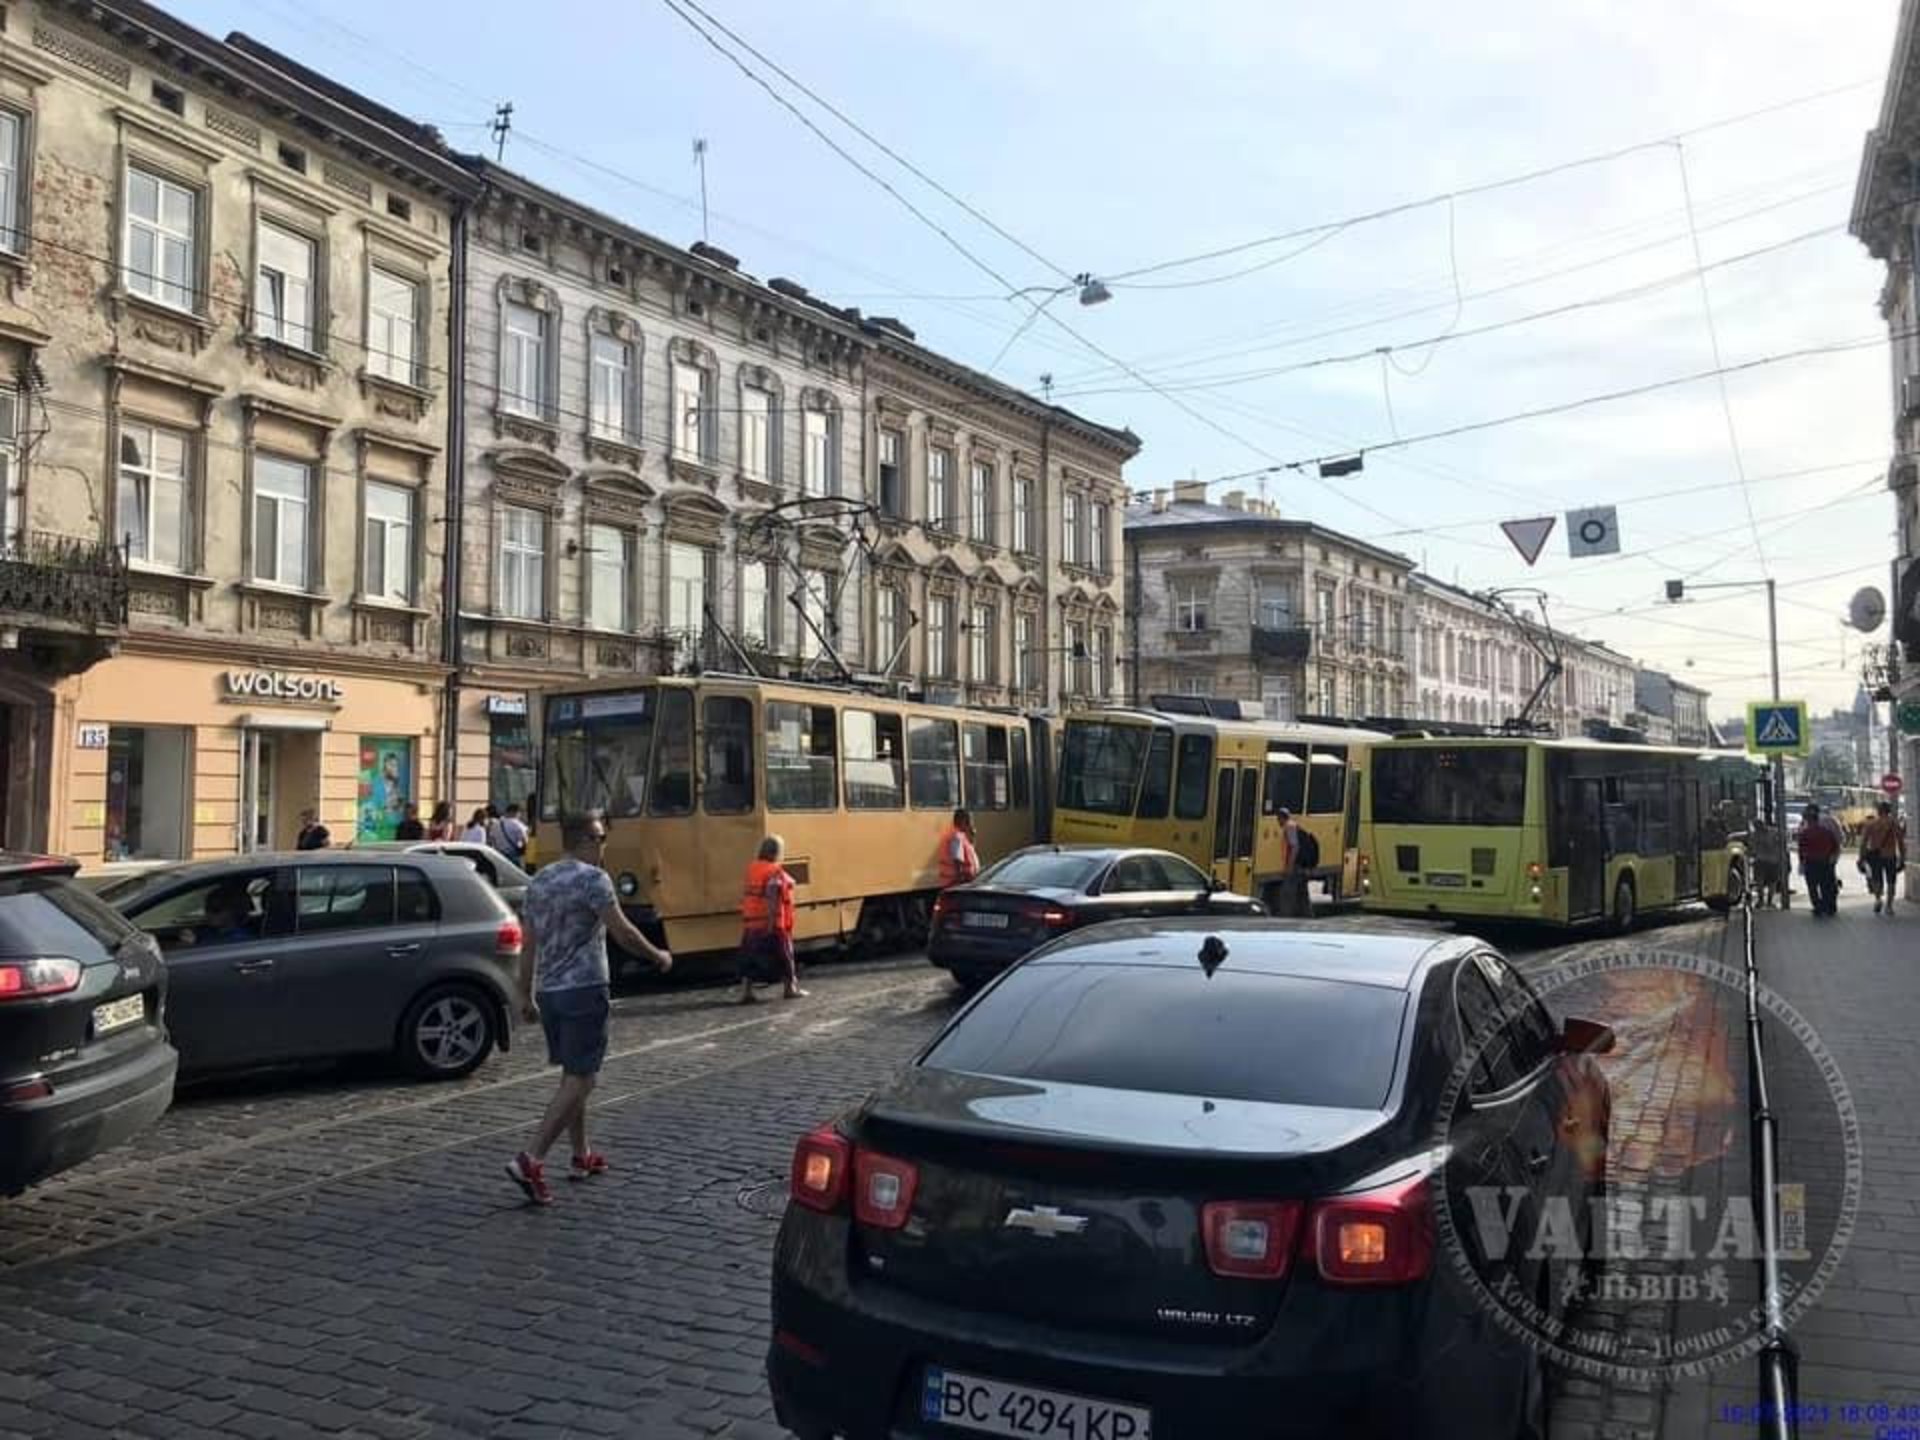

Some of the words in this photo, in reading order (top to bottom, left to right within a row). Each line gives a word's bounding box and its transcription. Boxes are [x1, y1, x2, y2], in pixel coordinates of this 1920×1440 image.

[227, 670, 344, 699] watsons
[944, 1380, 990, 1422] BC
[999, 1391, 1077, 1440] 4294
[1086, 1407, 1137, 1440] KP
